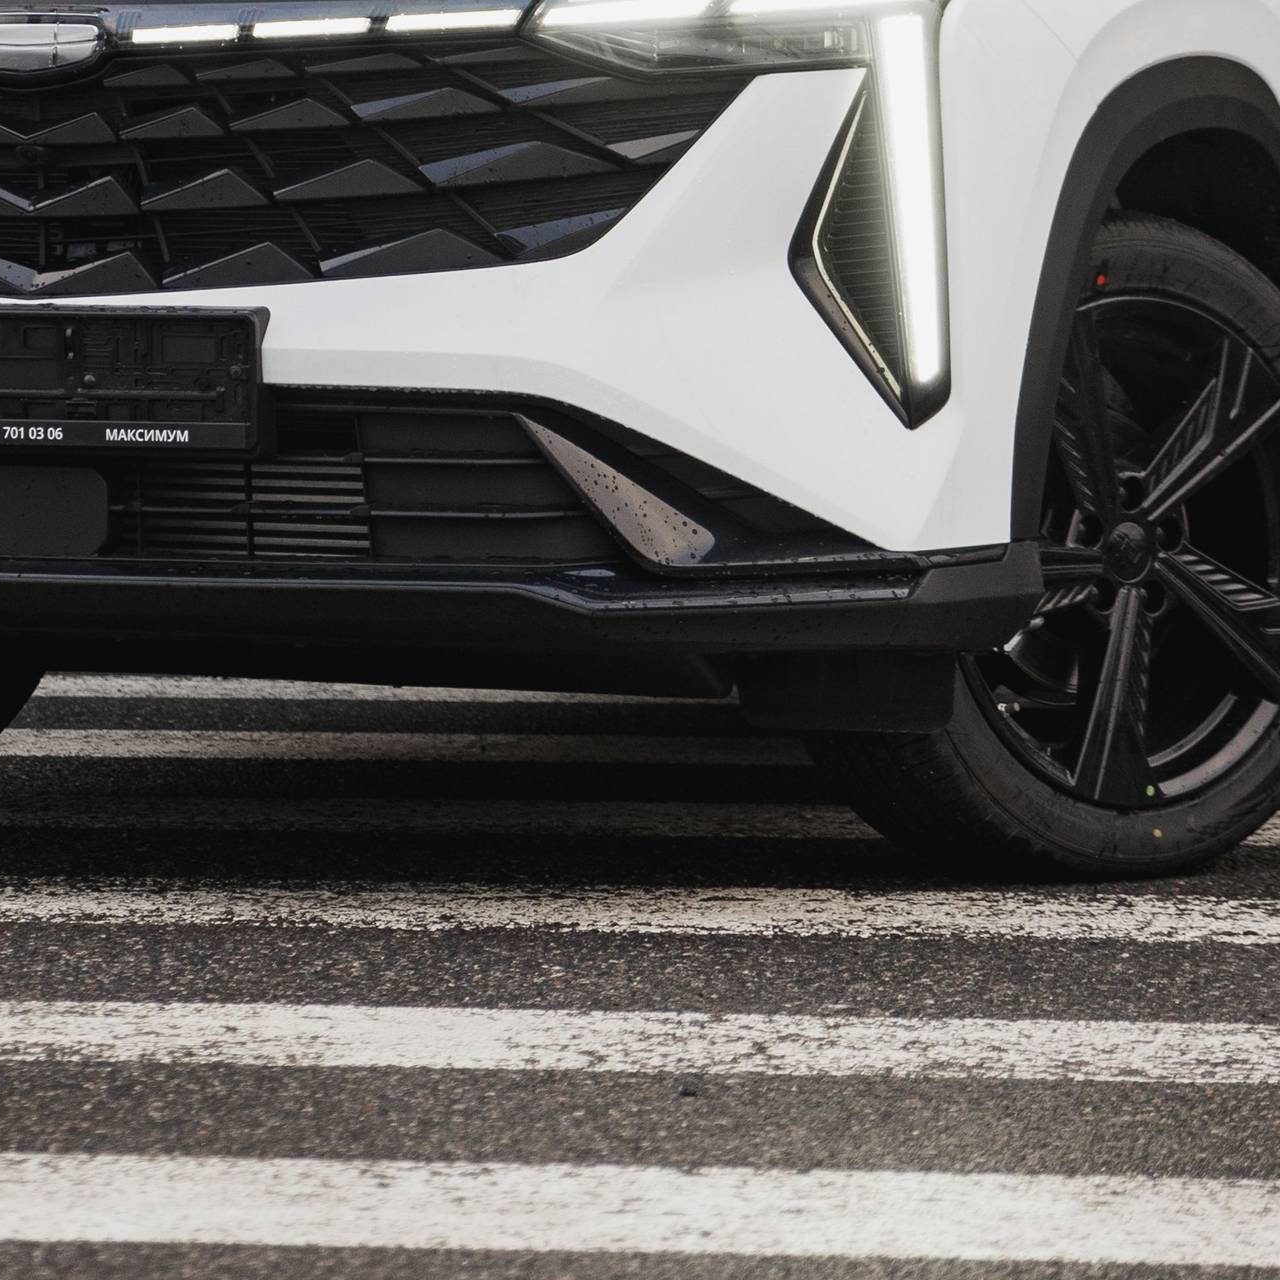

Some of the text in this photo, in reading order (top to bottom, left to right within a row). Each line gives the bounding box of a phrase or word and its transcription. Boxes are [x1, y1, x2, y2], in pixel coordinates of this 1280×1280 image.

[3, 426, 25, 440] 701
[28, 427, 45, 440] 03
[47, 427, 64, 441] 06
[105, 428, 189, 443] МАКСИМУМ
